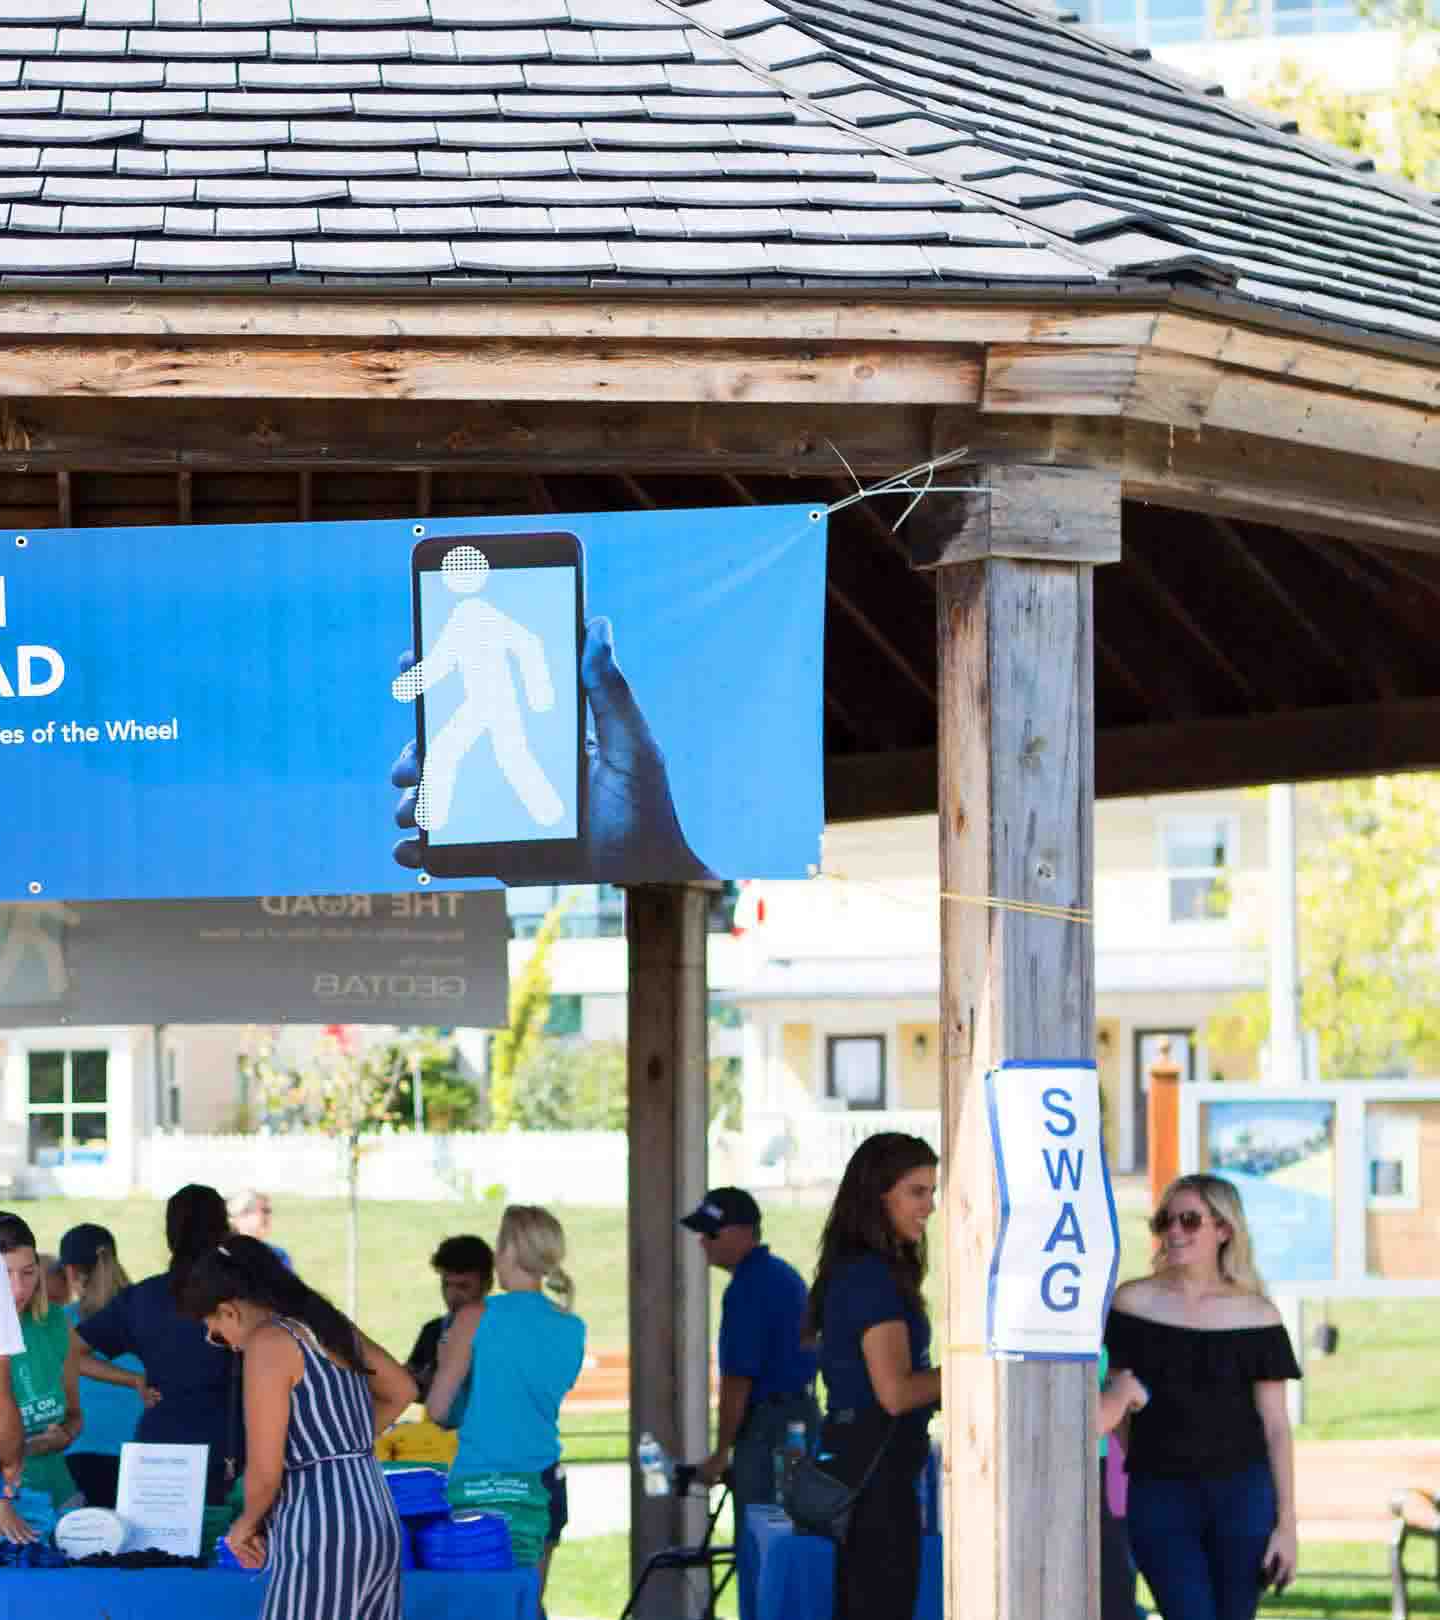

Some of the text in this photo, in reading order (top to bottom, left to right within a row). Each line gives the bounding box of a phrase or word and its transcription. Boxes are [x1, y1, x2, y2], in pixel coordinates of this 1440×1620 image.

[31, 722, 55, 743] of
[62, 722, 99, 743] the
[106, 719, 178, 742] Wheel
[1040, 1087, 1086, 1312] SWAG
